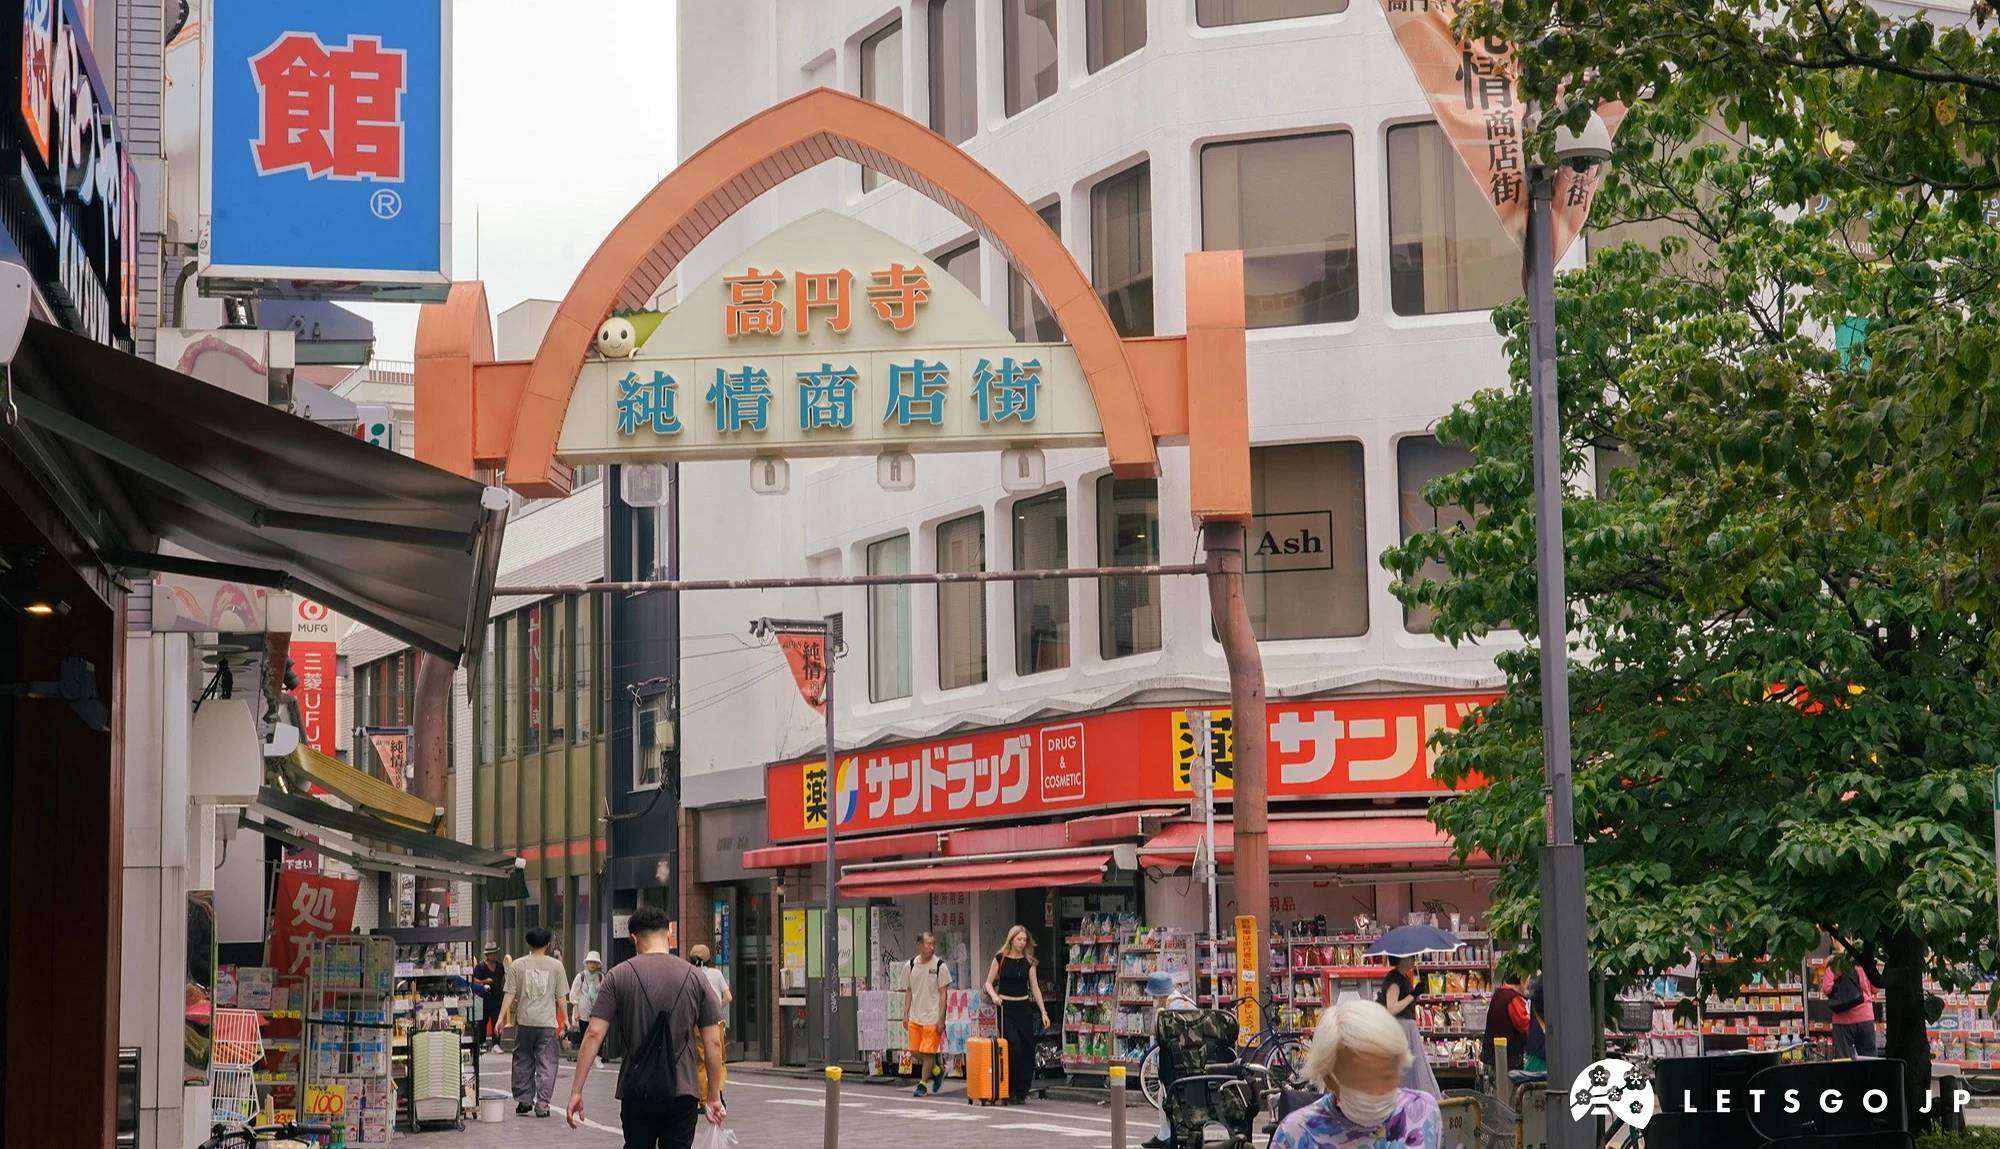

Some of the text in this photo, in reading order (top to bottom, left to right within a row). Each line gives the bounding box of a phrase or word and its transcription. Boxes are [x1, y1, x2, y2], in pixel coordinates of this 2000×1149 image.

[249, 31, 407, 183] 館
[722, 263, 931, 337] 高円寺
[616, 357, 1042, 435] 純情商店街
[1254, 529, 1323, 556] Ash
[298, 624, 328, 633] MUFG
[304, 653, 321, 751] 三菱UFJ
[1048, 736, 1076, 751] DRUG
[1060, 756, 1066, 769] &
[806, 769, 827, 824] 薬
[865, 734, 1031, 819] サンドラッグ
[1044, 772, 1081, 789] COSMETIC
[313, 1094, 343, 1113] 100
